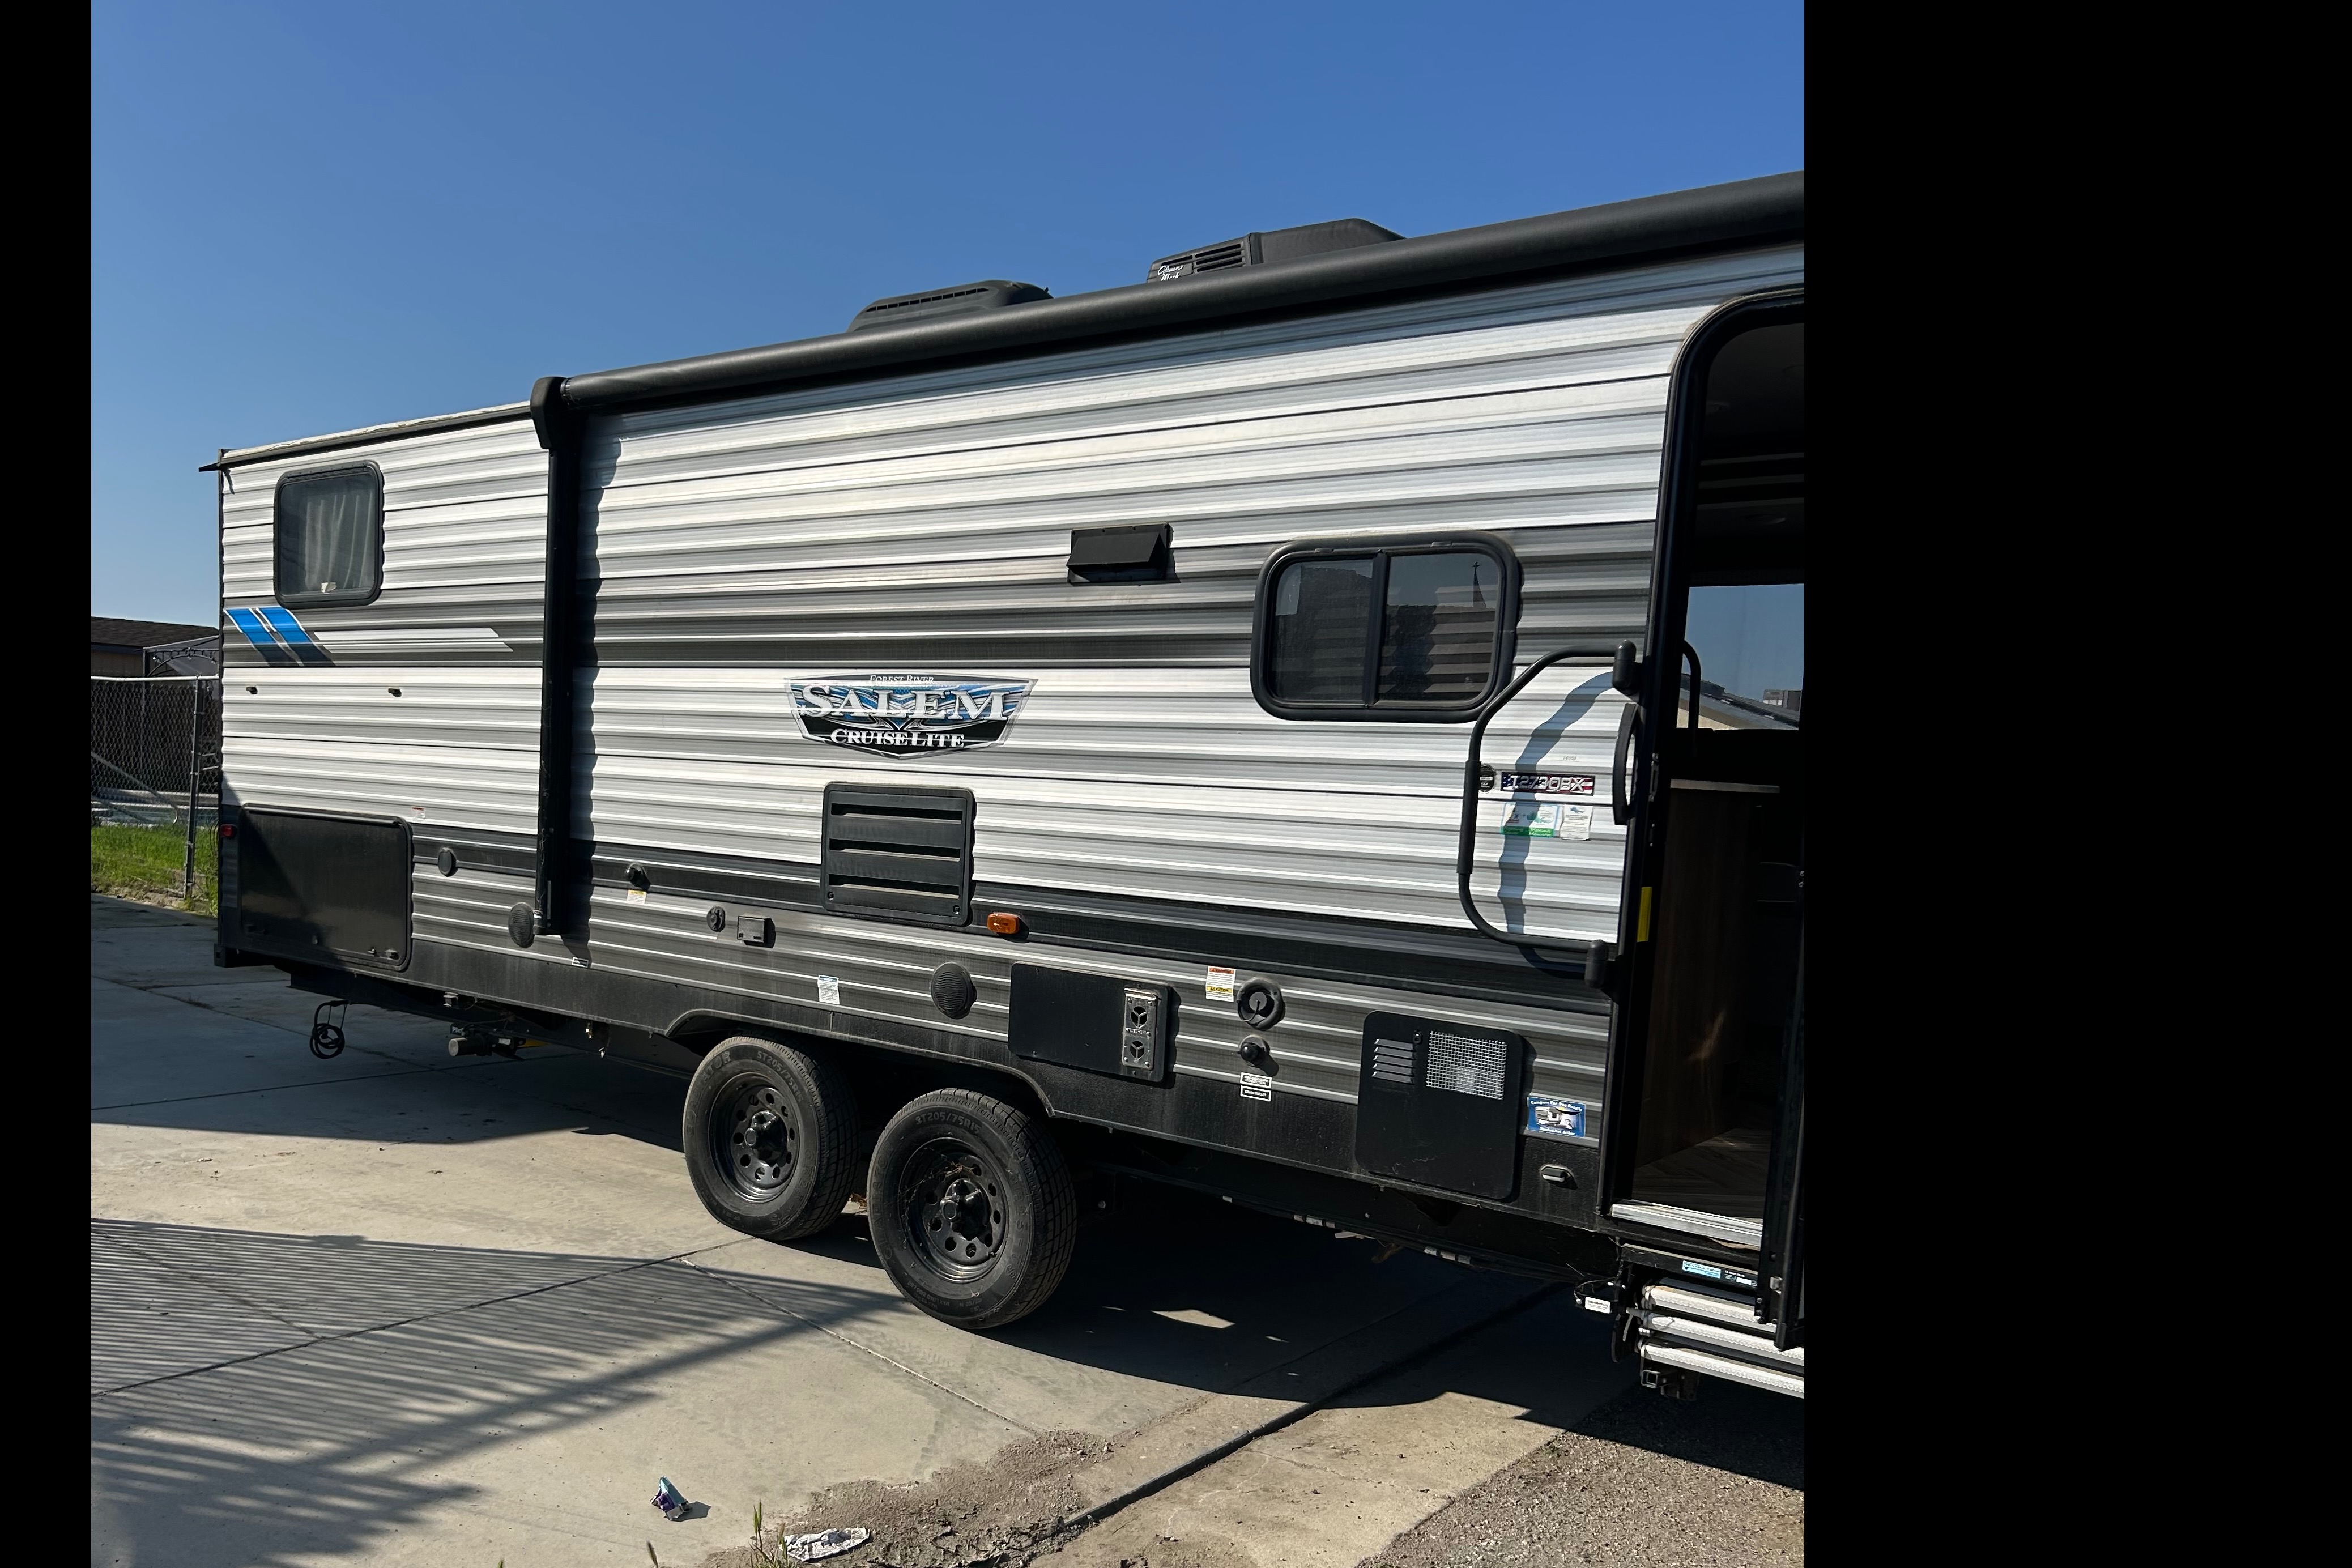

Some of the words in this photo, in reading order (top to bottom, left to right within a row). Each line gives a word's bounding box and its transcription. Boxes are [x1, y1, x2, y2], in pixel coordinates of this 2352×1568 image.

[906, 675, 935, 684] RIVER
[802, 684, 1010, 721] SALEM
[1510, 775, 1585, 792] T273QBX
[756, 1050, 804, 1103] ST205/75R15
[915, 1111, 982, 1134] ST205/75R15
